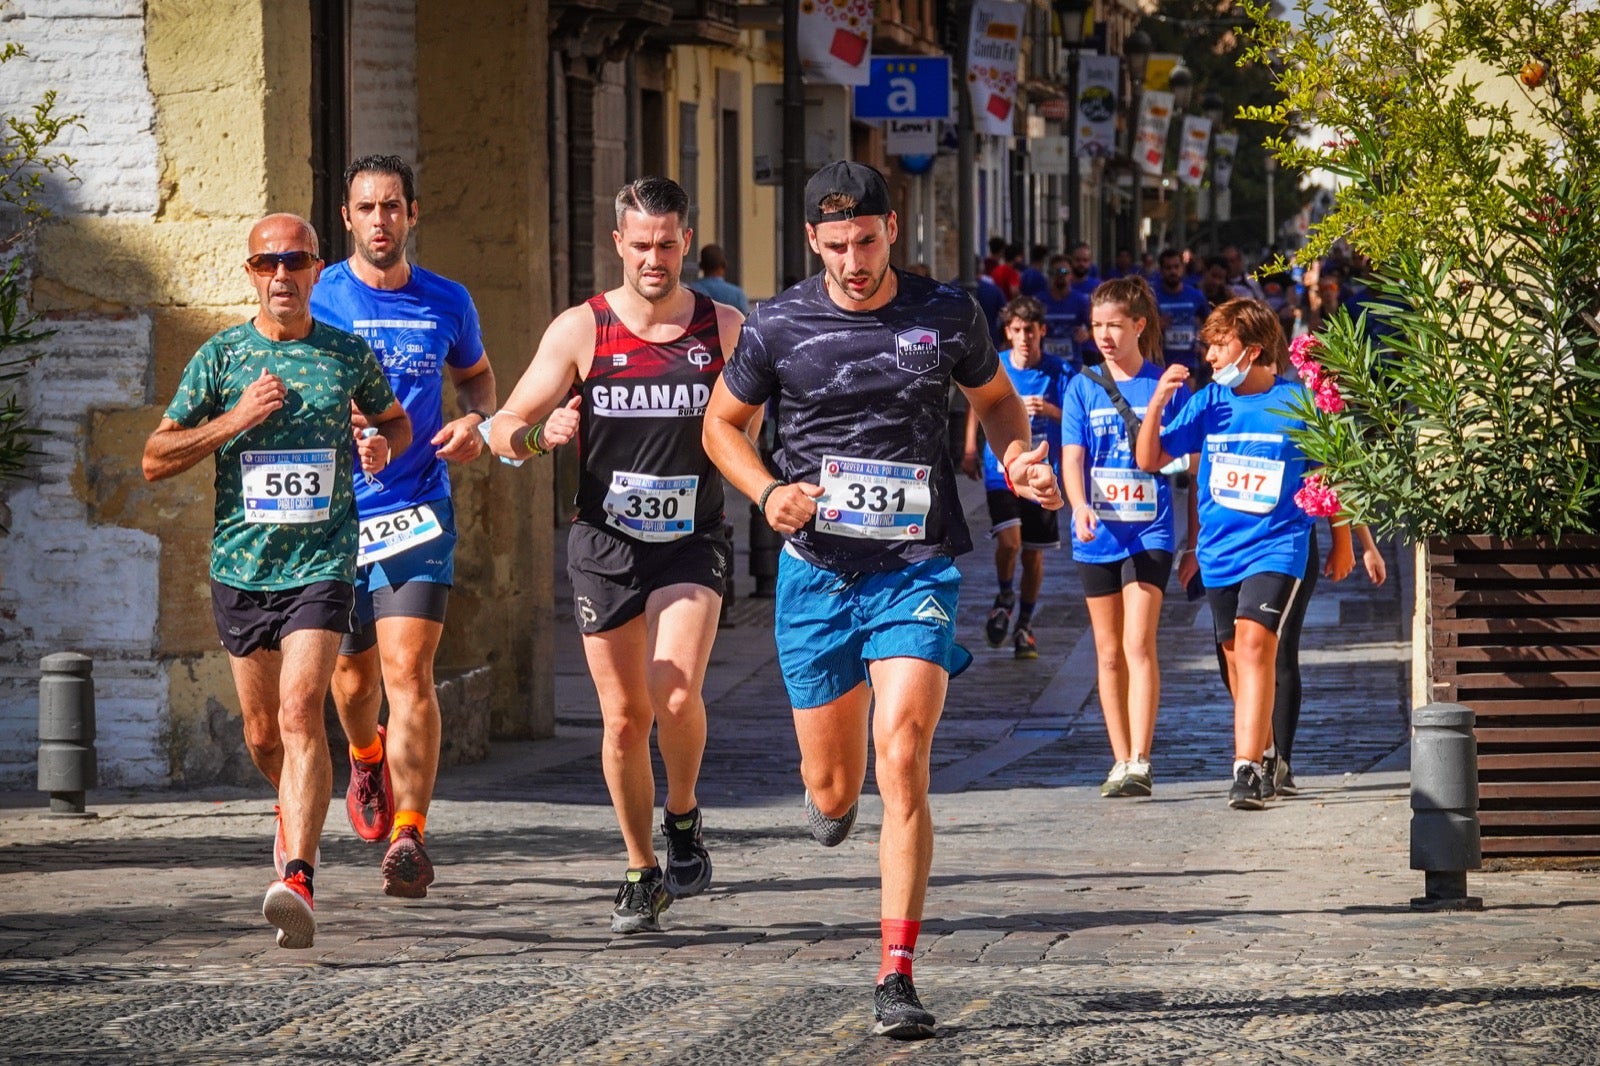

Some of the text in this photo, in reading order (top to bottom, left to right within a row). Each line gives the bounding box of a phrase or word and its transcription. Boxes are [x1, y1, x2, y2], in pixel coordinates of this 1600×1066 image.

[887, 77, 917, 113] a
[891, 120, 932, 133] Lowi
[592, 384, 710, 410] GRANAD
[265, 472, 321, 497] 563
[1106, 484, 1145, 501] 914
[1227, 470, 1267, 492] 917
[625, 495, 678, 519] 330
[846, 483, 906, 512] 331
[360, 506, 425, 542] 1261
